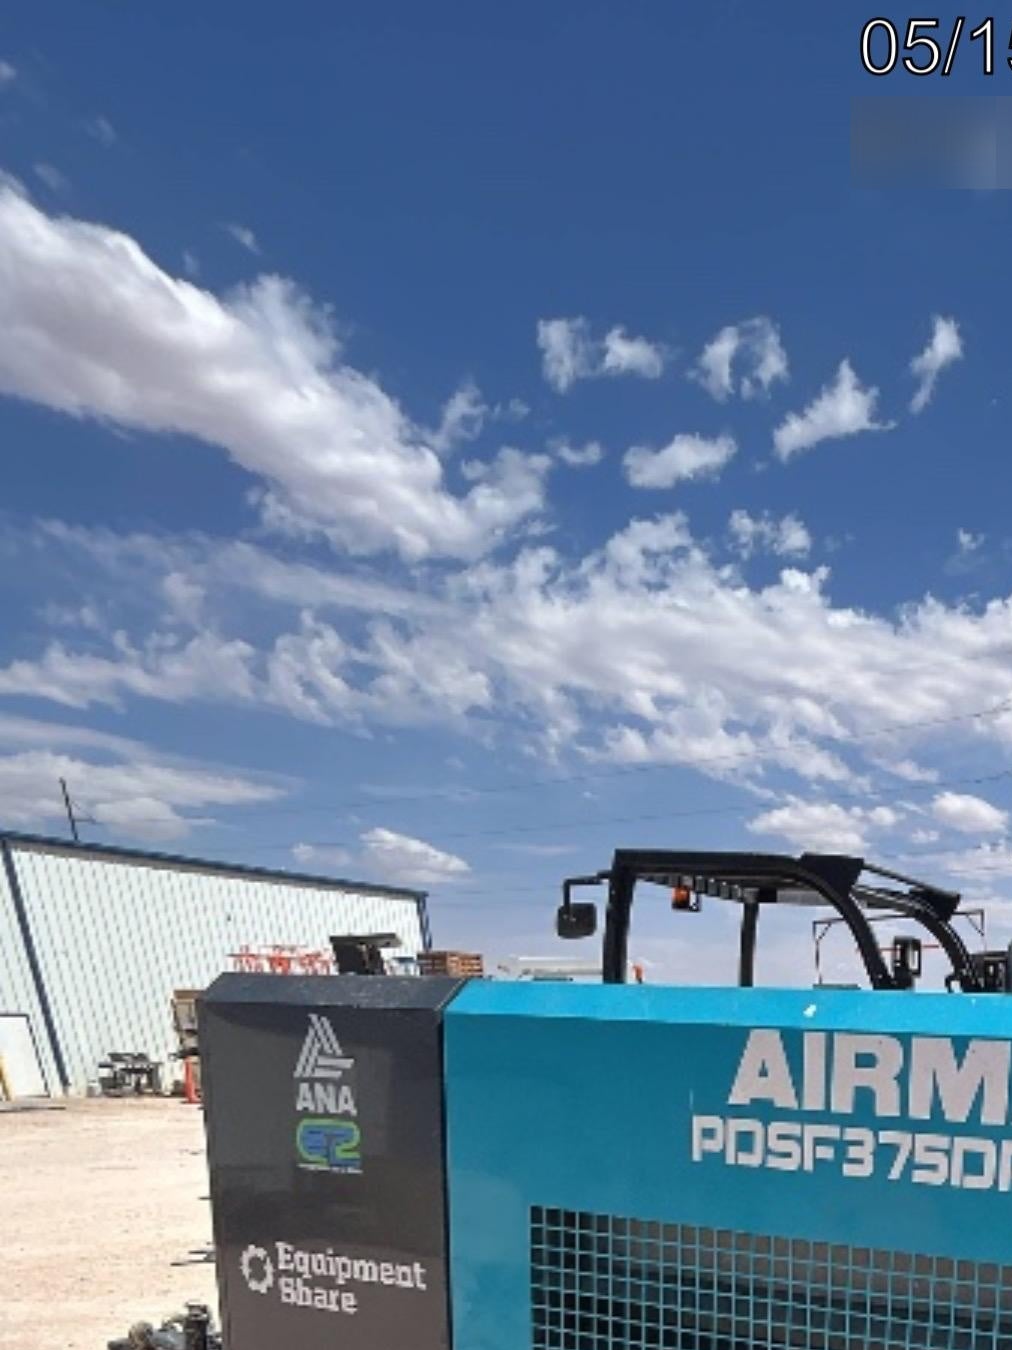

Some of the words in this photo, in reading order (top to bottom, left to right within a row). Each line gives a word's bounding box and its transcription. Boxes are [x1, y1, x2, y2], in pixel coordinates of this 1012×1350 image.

[296, 1082, 358, 1117] ANA
[275, 1241, 427, 1291] Equipment
[279, 1277, 358, 1316] Share
